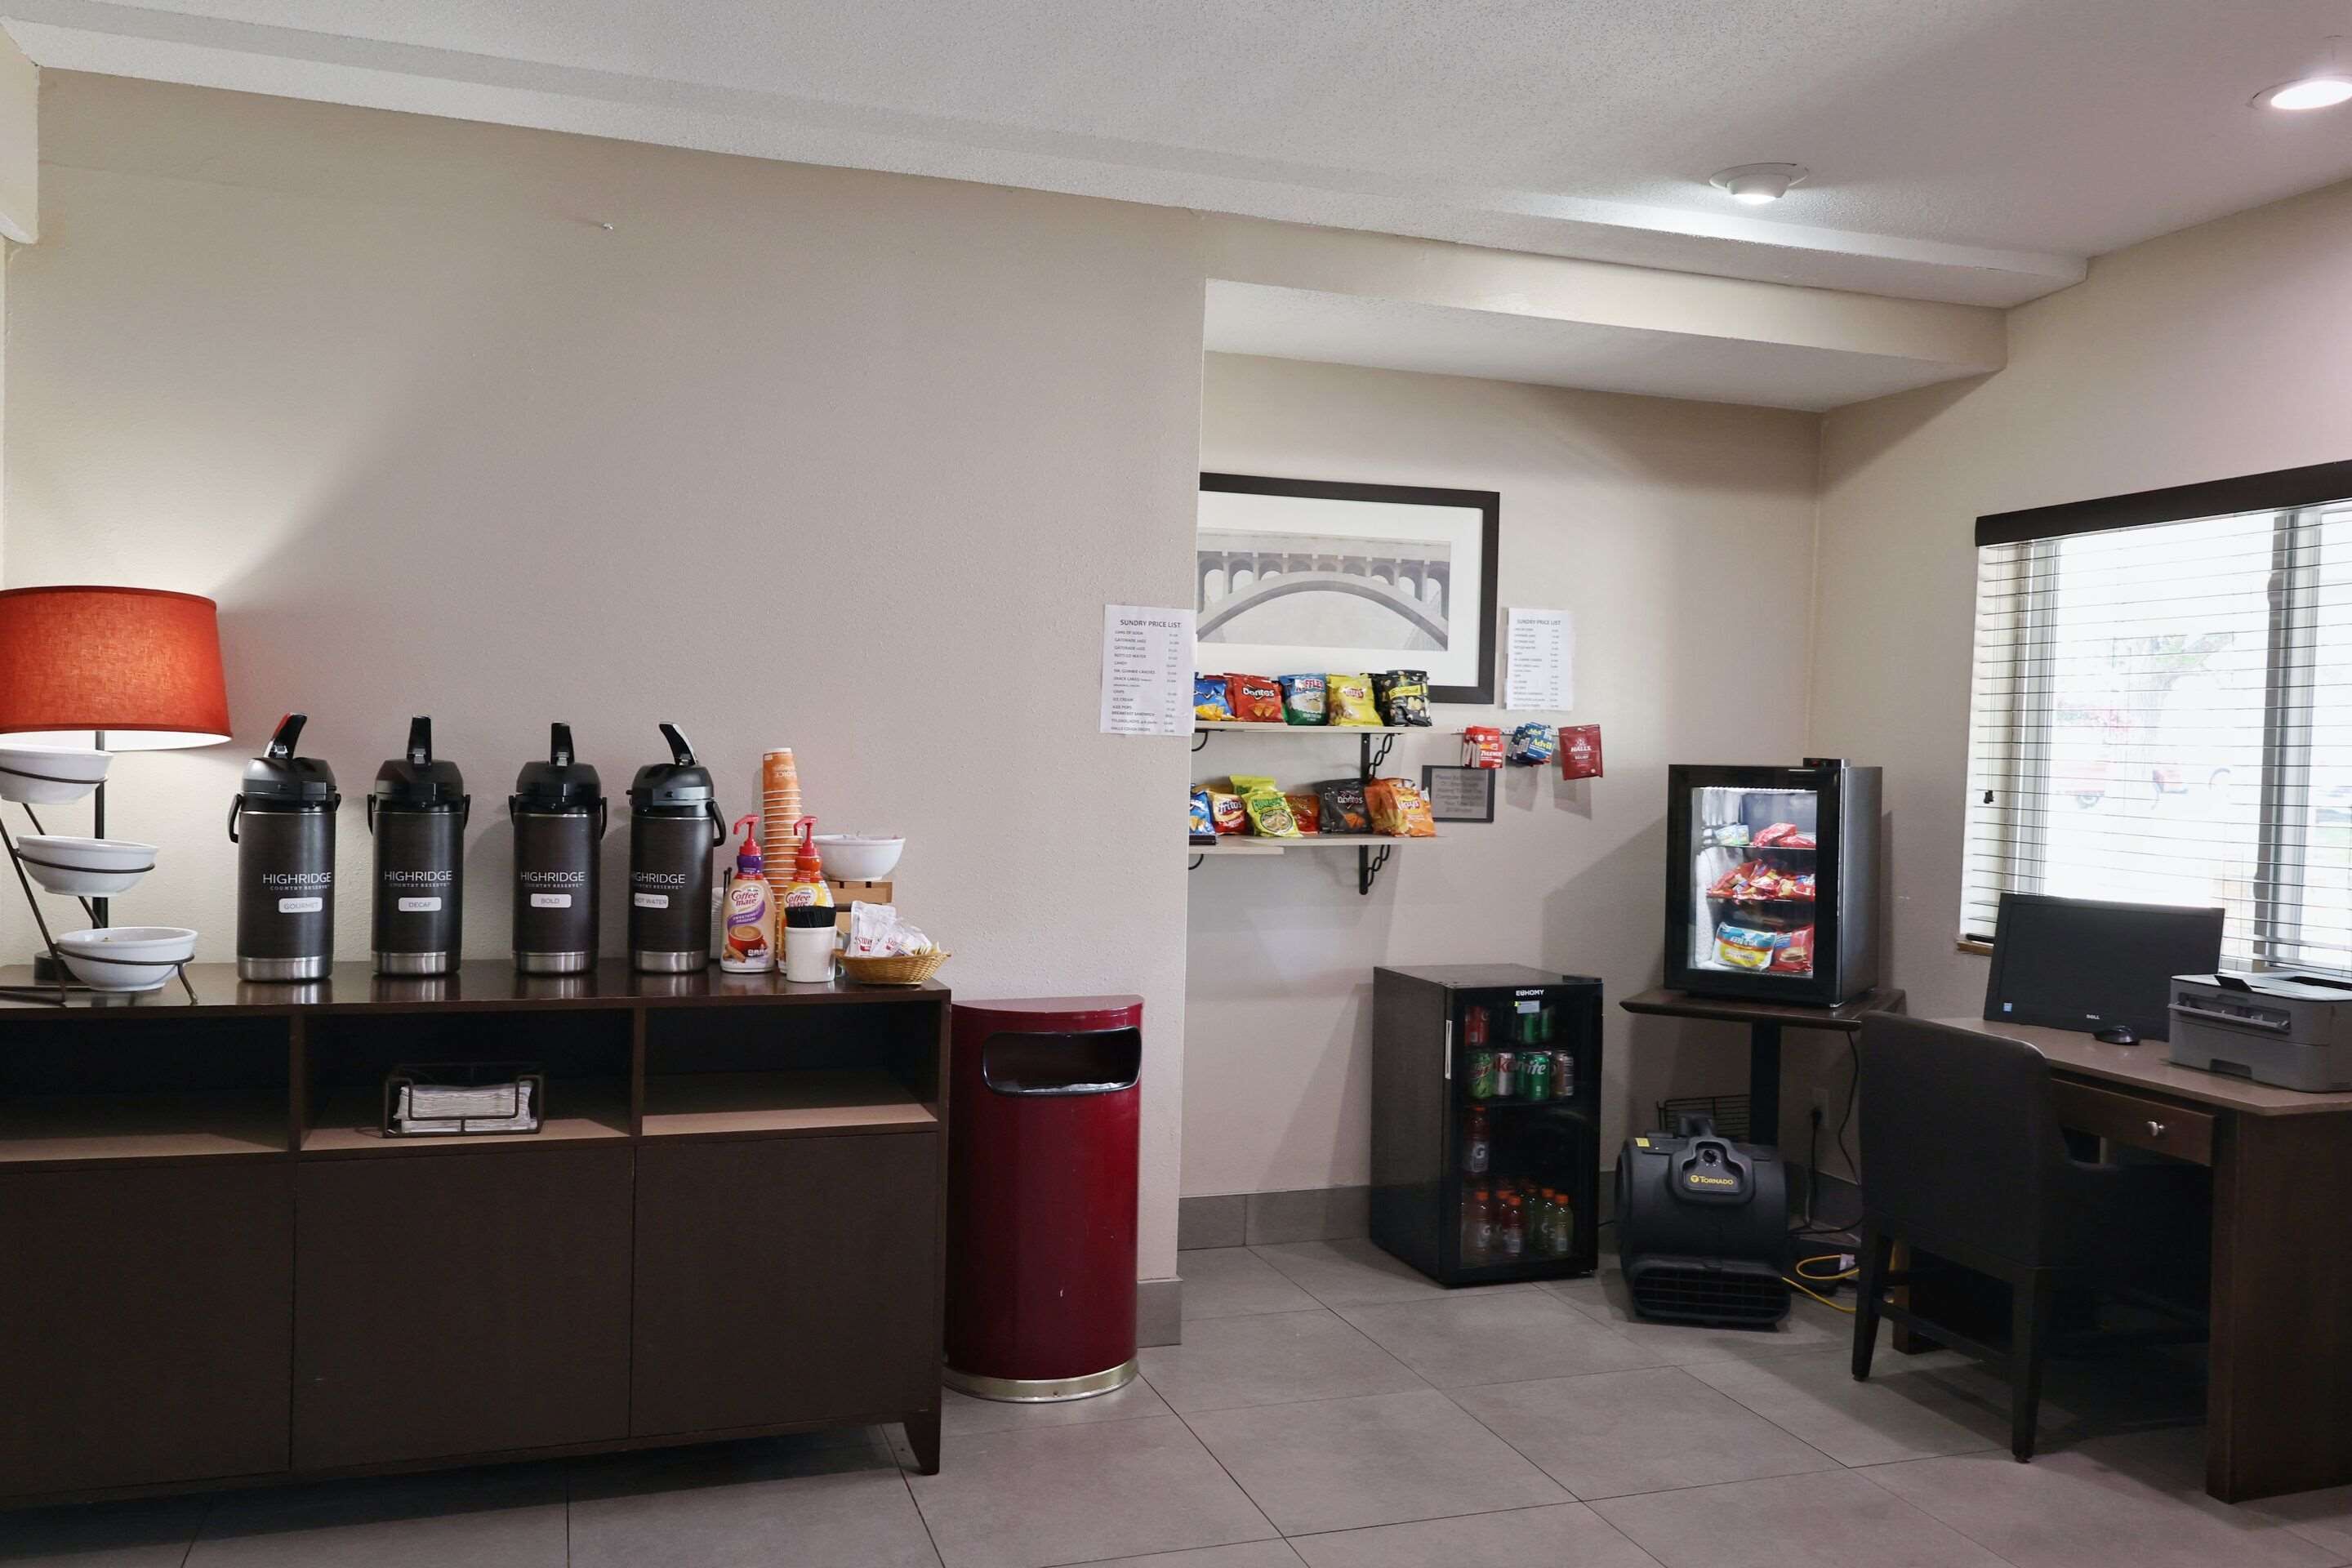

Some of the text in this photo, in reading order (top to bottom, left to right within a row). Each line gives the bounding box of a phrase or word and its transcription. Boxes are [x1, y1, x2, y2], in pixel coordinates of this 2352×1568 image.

[1296, 679, 1324, 692] RFFLES
[1242, 687, 1275, 697] Doritos
[1532, 738, 1552, 750] Advil
[1338, 795, 1363, 804] Doritos
[262, 871, 332, 884] HIGHRIDGE
[384, 871, 452, 881] HIGHRIDGE
[520, 871, 586, 882] HIGHRIDGE
[633, 871, 686, 884] GHRIDGE
[731, 889, 759, 901] Coffee
[786, 892, 811, 903] Coffee
[283, 902, 319, 910] GOURMET
[736, 898, 757, 906] mate
[1699, 1175, 1734, 1184] TORNADO
